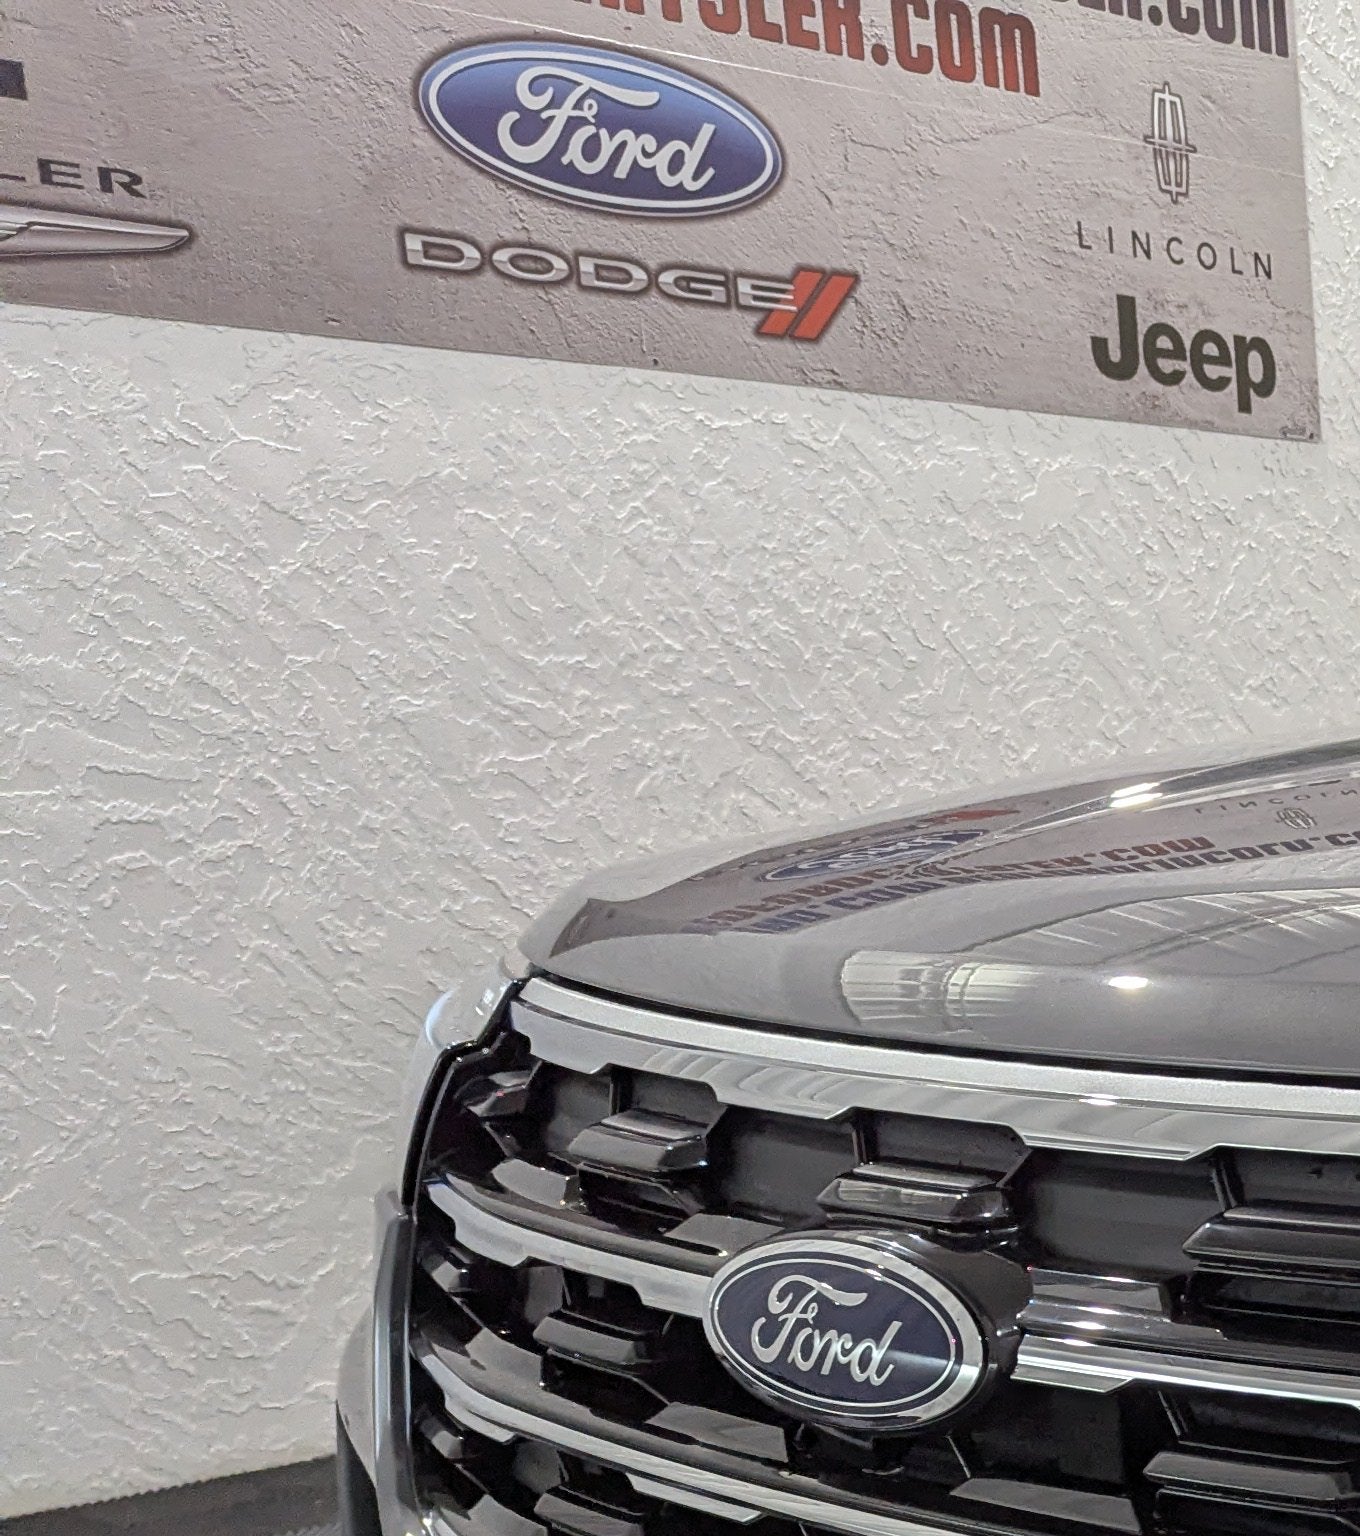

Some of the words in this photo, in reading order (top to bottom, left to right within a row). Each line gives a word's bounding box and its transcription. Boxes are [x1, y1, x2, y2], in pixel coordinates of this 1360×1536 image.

[497, 65, 716, 192] Ford
[0, 157, 147, 199] ER
[403, 231, 798, 312] DODGE
[1076, 220, 1272, 280] LINCOLN
[1090, 293, 1277, 415] Jeep
[751, 1275, 903, 1386] Ford
